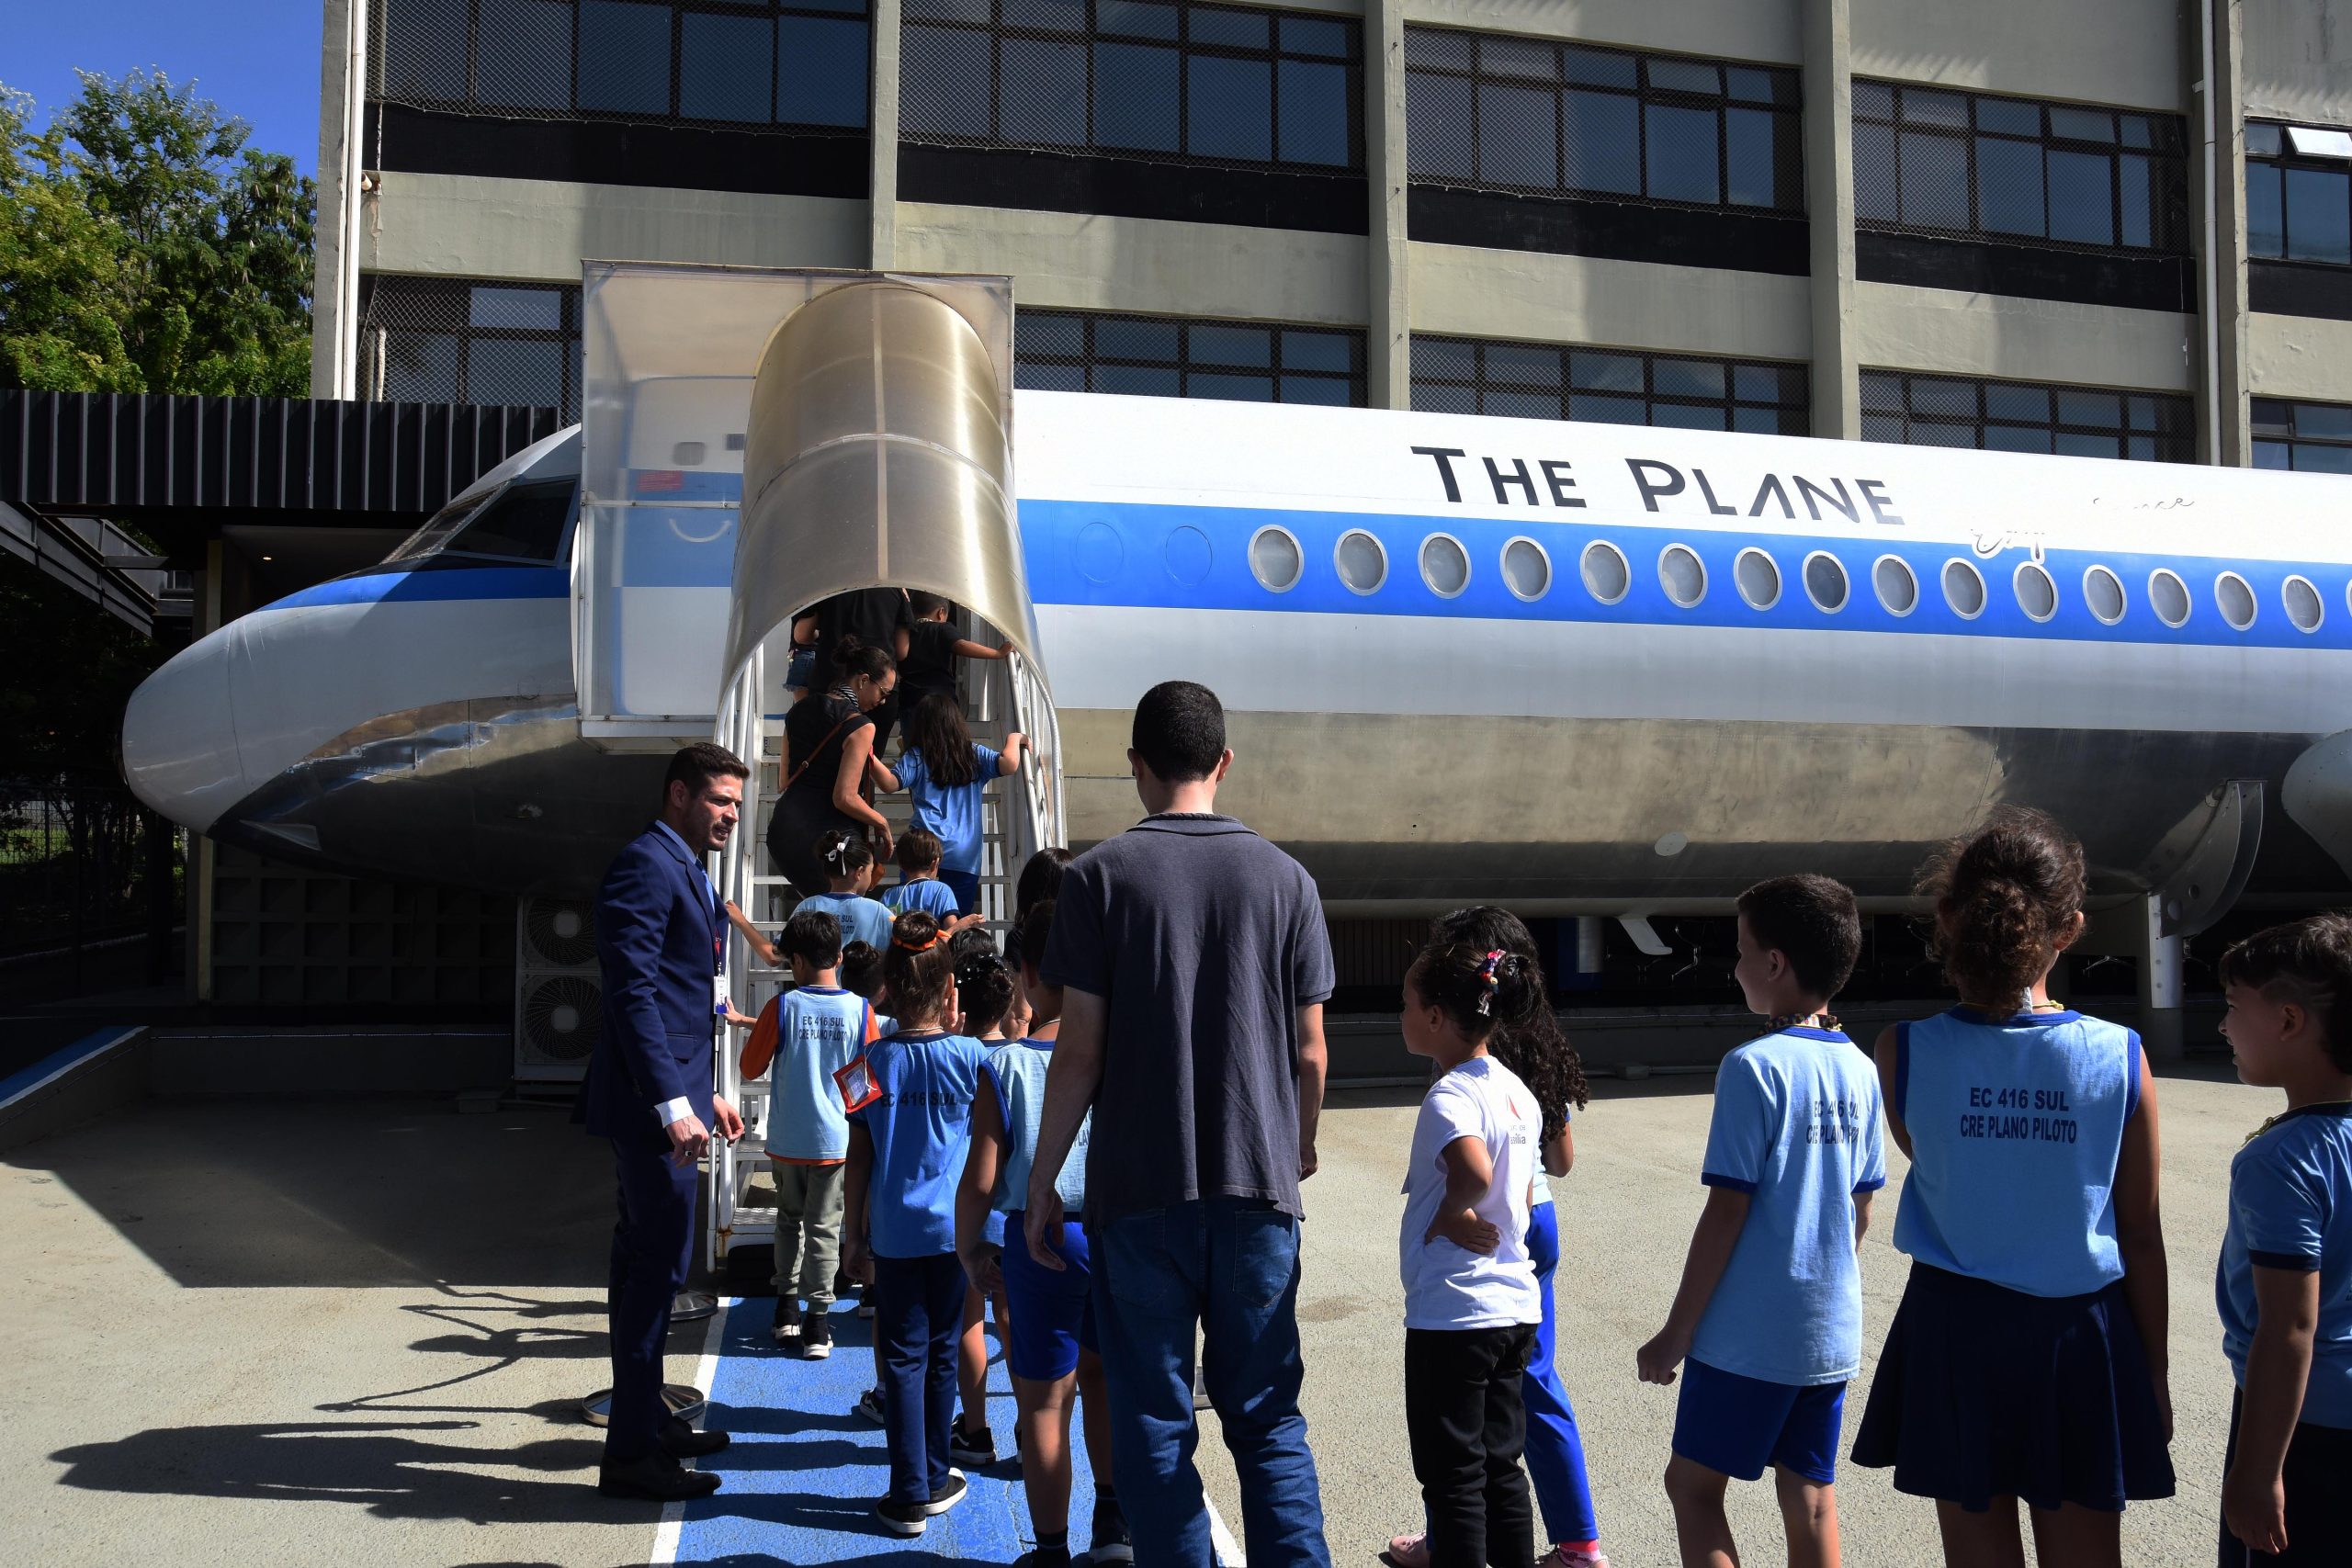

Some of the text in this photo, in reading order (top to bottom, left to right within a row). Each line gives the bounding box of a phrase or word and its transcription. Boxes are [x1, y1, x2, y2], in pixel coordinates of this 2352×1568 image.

[1410, 446, 1905, 525] THE PLANE
[802, 1016, 845, 1027] EC 416 SUL
[900, 1091, 927, 1107] 416
[930, 1092, 957, 1107] SUL
[1970, 1087, 2070, 1111] EC 416 SUL
[1960, 1113, 2077, 1145] CRE PLANO PILOTO
